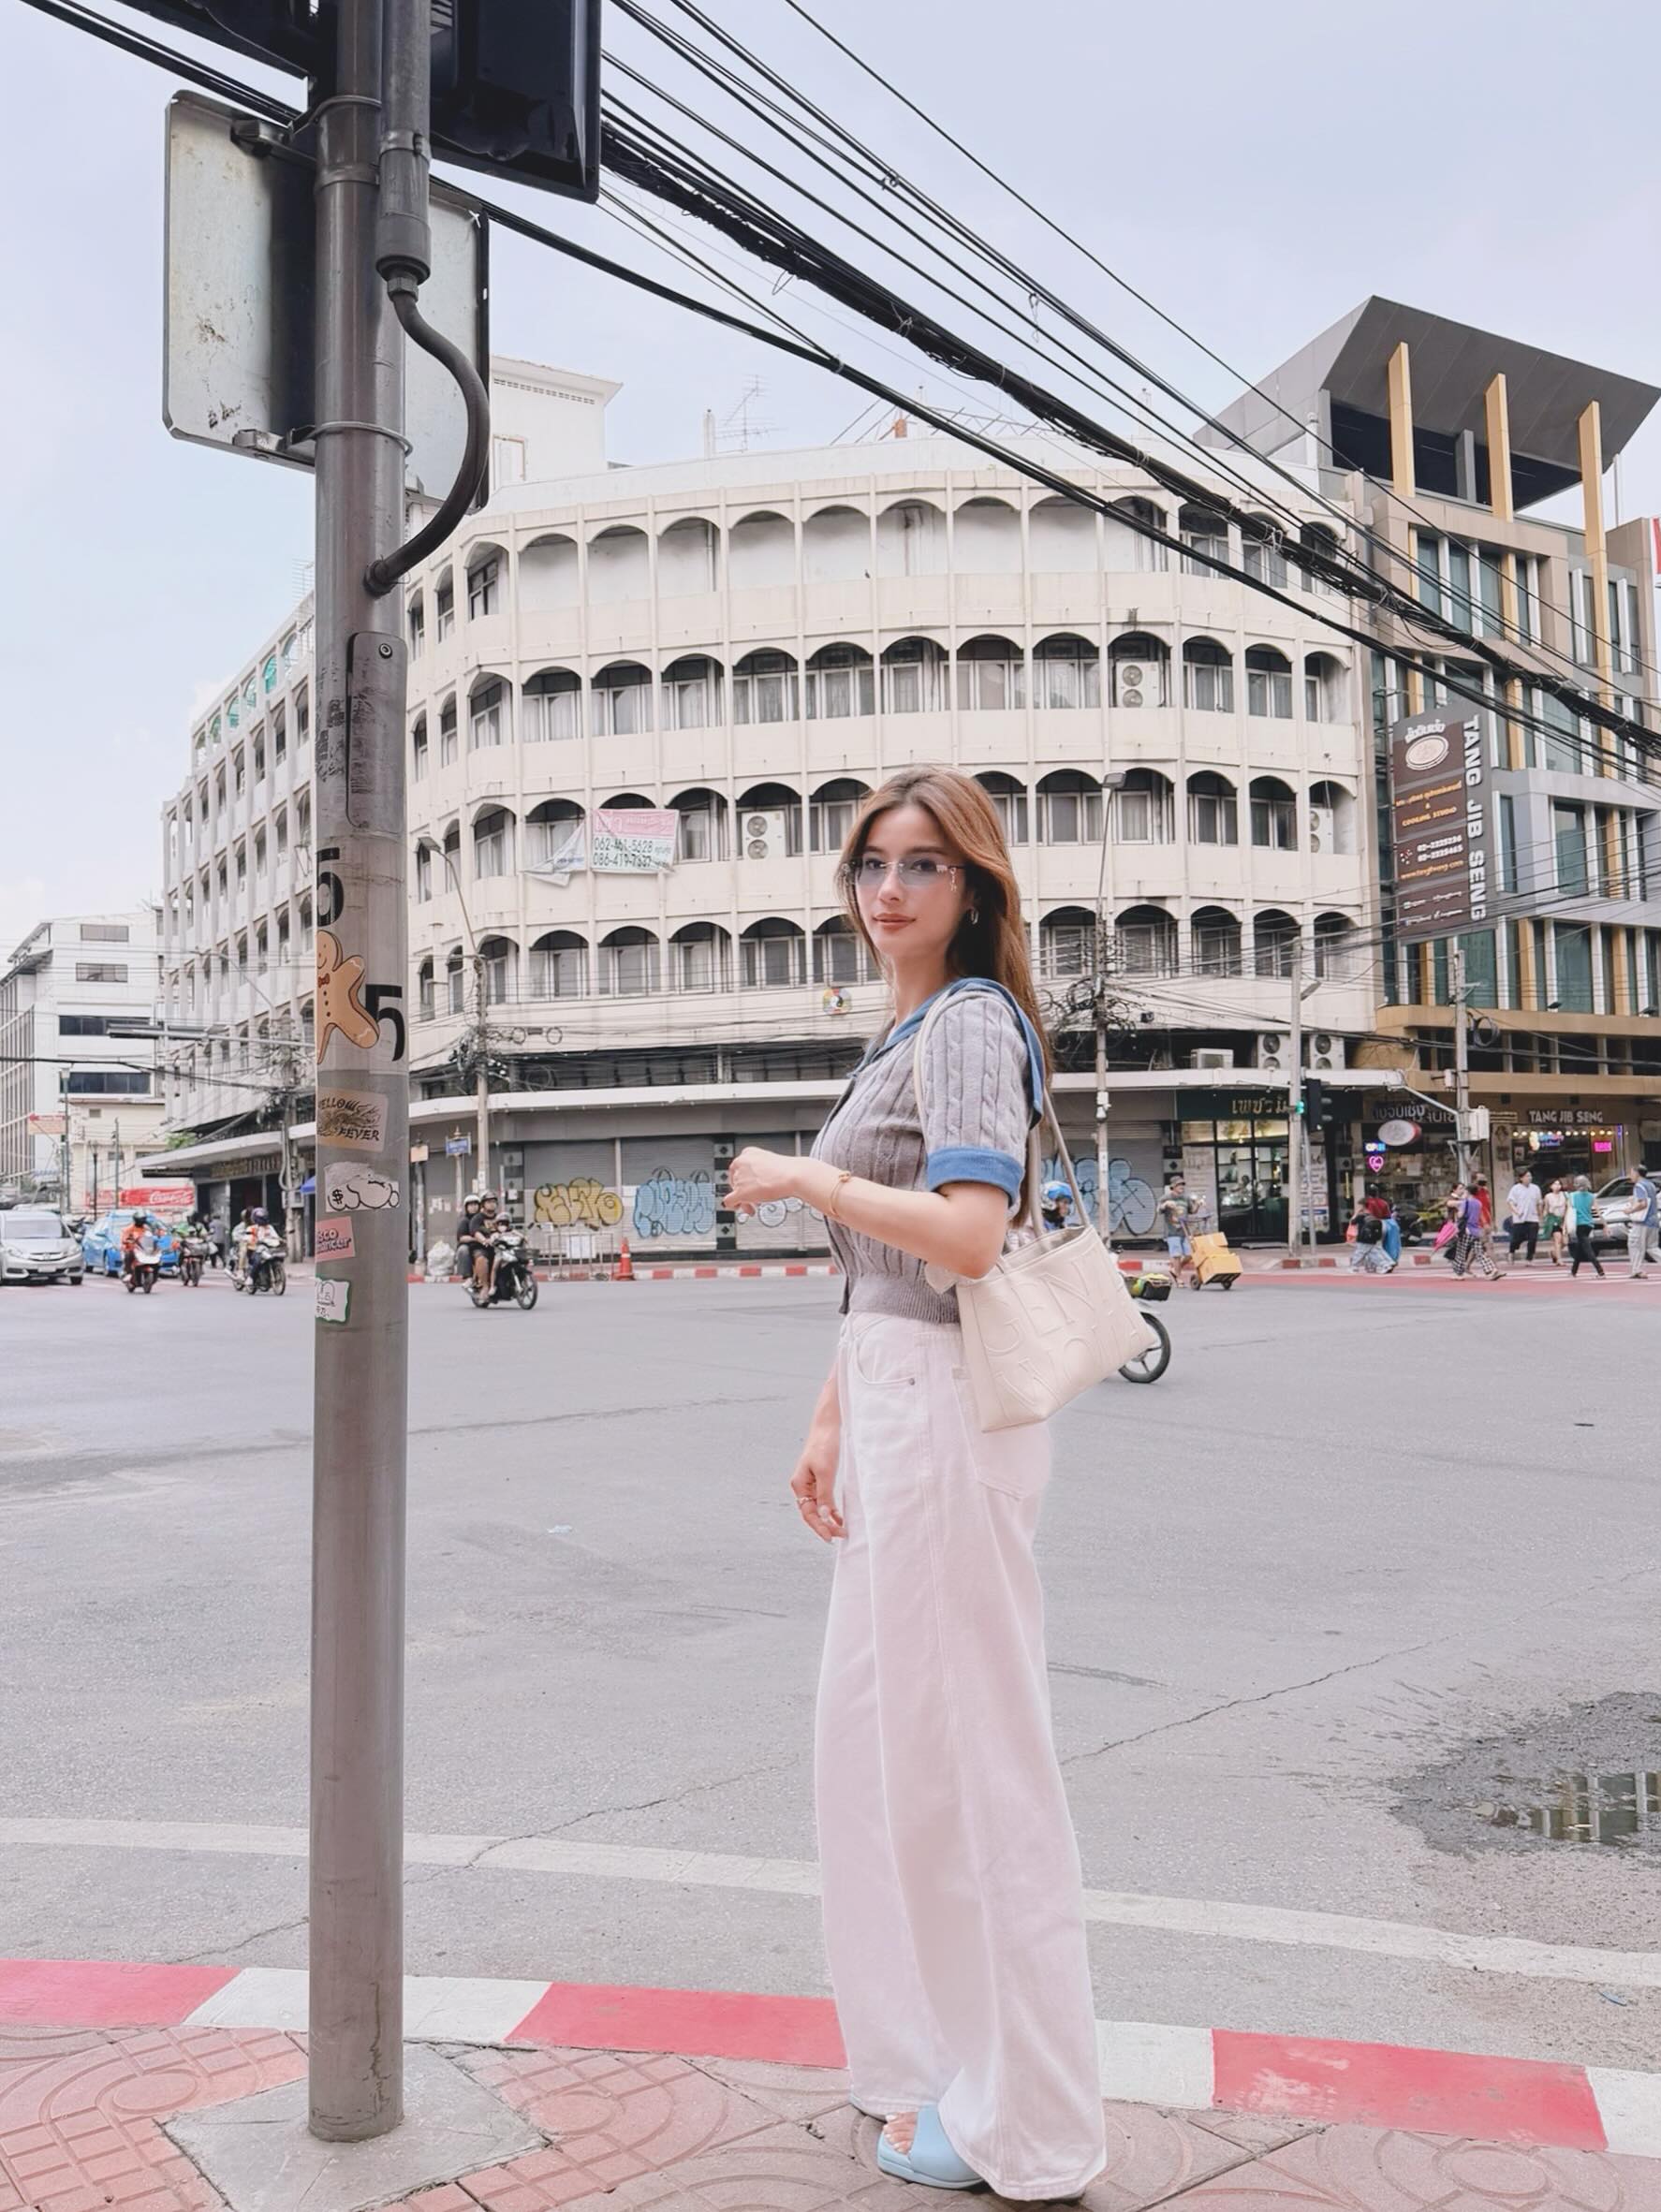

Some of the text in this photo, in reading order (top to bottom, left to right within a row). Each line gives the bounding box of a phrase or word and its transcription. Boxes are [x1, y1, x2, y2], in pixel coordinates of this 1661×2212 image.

[1463, 714, 1487, 922] TANG JIB SENG
[365, 984, 405, 1062] 5
[337, 1127, 379, 1141] FEVER
[1529, 1110, 1603, 1123] TANG JIB SENG
